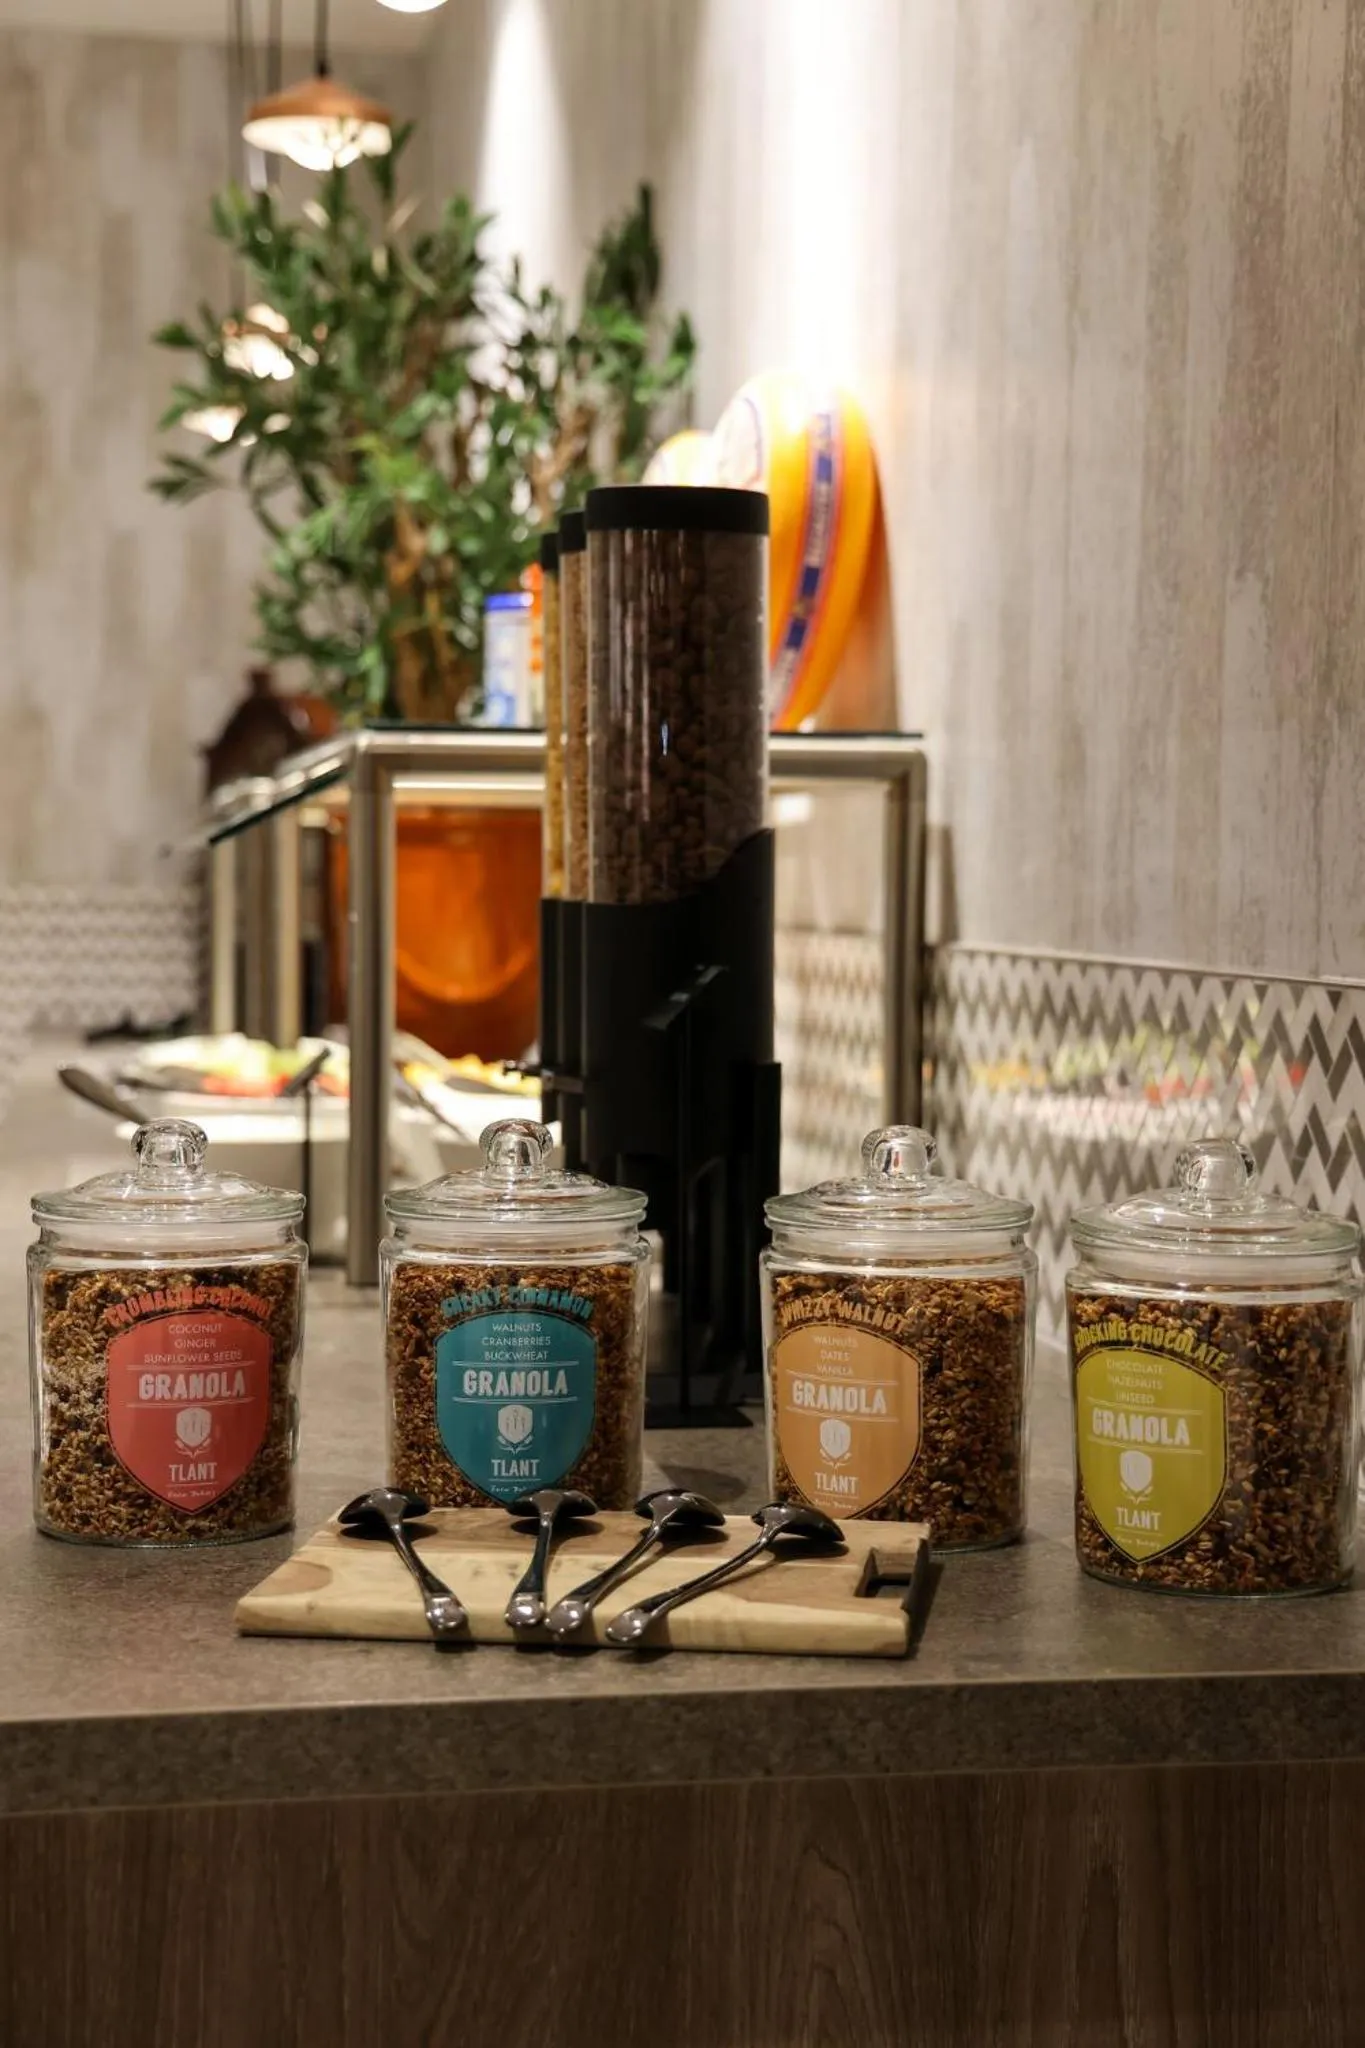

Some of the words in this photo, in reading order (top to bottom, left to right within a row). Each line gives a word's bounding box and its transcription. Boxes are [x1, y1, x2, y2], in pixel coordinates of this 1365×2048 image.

[492, 1322, 542, 1333] WALNUTS
[838, 1301, 908, 1335] WALNUT
[168, 1323, 224, 1335] COCONUT
[174, 1337, 216, 1349] GINGER
[481, 1336, 551, 1347] CRANBERRIES
[1130, 1322, 1229, 1371] CHOCOLATE
[143, 1352, 210, 1364] SUNFLOWER
[213, 1350, 243, 1362] SEEDS
[484, 1351, 549, 1362] BUCKWHEAT
[1106, 1358, 1164, 1375] CHOCOLATE
[138, 1370, 246, 1401] GRANOLA
[462, 1369, 568, 1397] GRANOLA
[1107, 1374, 1163, 1391] HAZELNUTS
[792, 1379, 887, 1415] GRANOLA
[1092, 1407, 1191, 1447] GRANOLA
[168, 1461, 218, 1483] TLANT
[491, 1459, 540, 1478] TLANT
[815, 1472, 859, 1494] TLANT
[1115, 1506, 1162, 1531] TLANT
